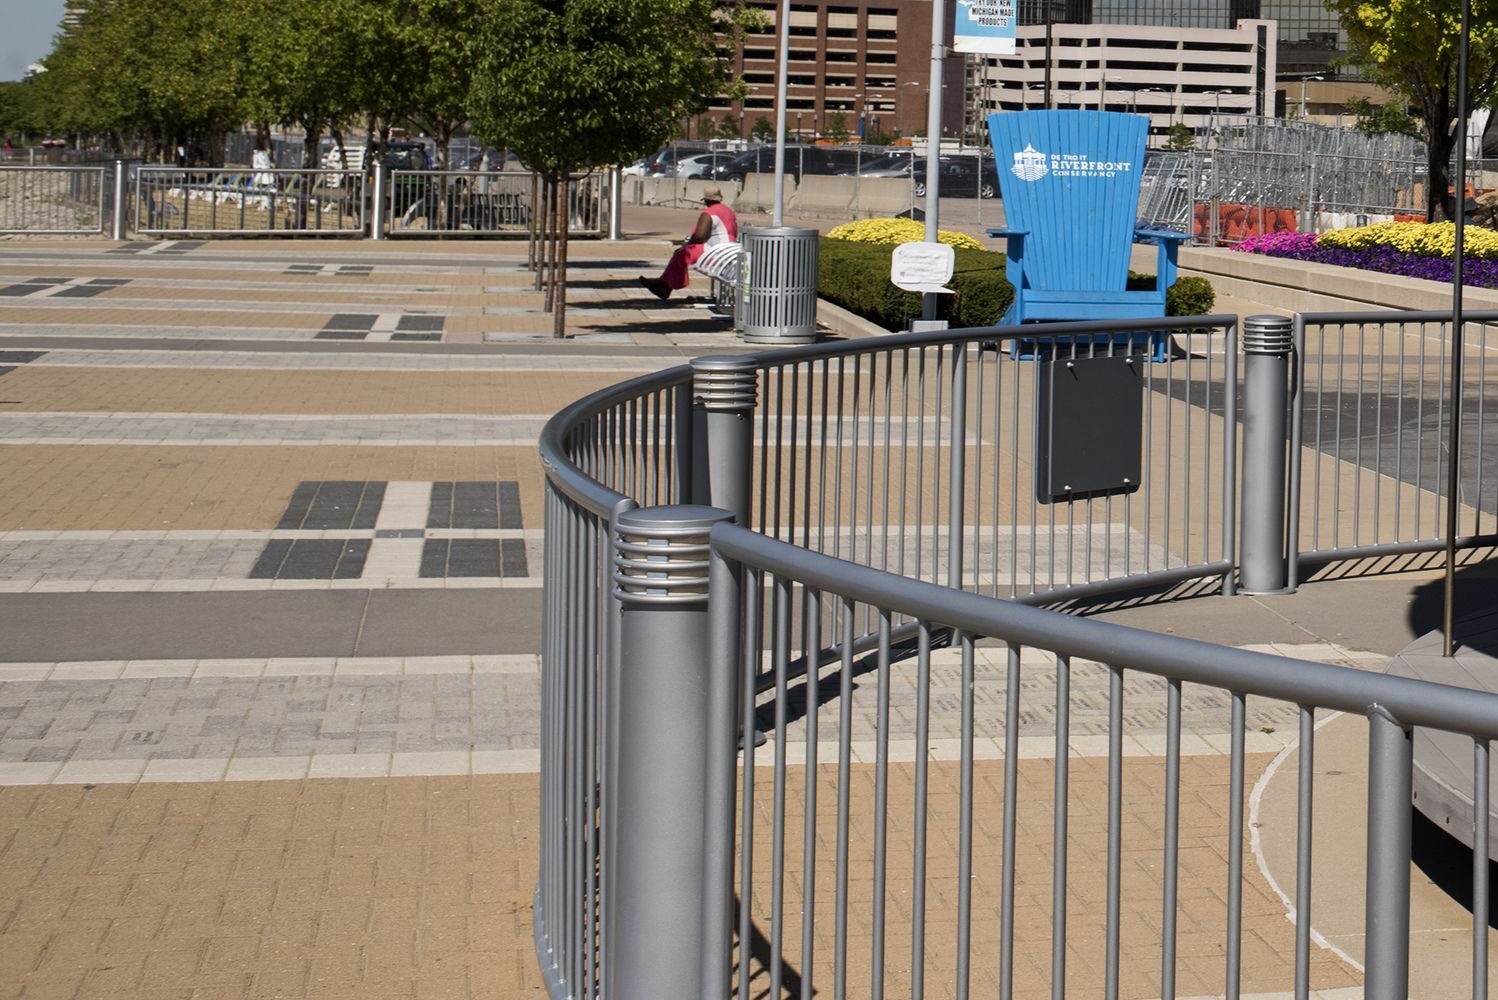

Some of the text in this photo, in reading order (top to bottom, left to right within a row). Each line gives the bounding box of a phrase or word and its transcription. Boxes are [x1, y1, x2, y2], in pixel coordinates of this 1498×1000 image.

[972, 7, 1014, 16] MICHIGAN MADE
[978, 17, 1007, 26] PRODUCTS
[1052, 161, 1130, 171] RIVERFRONT
